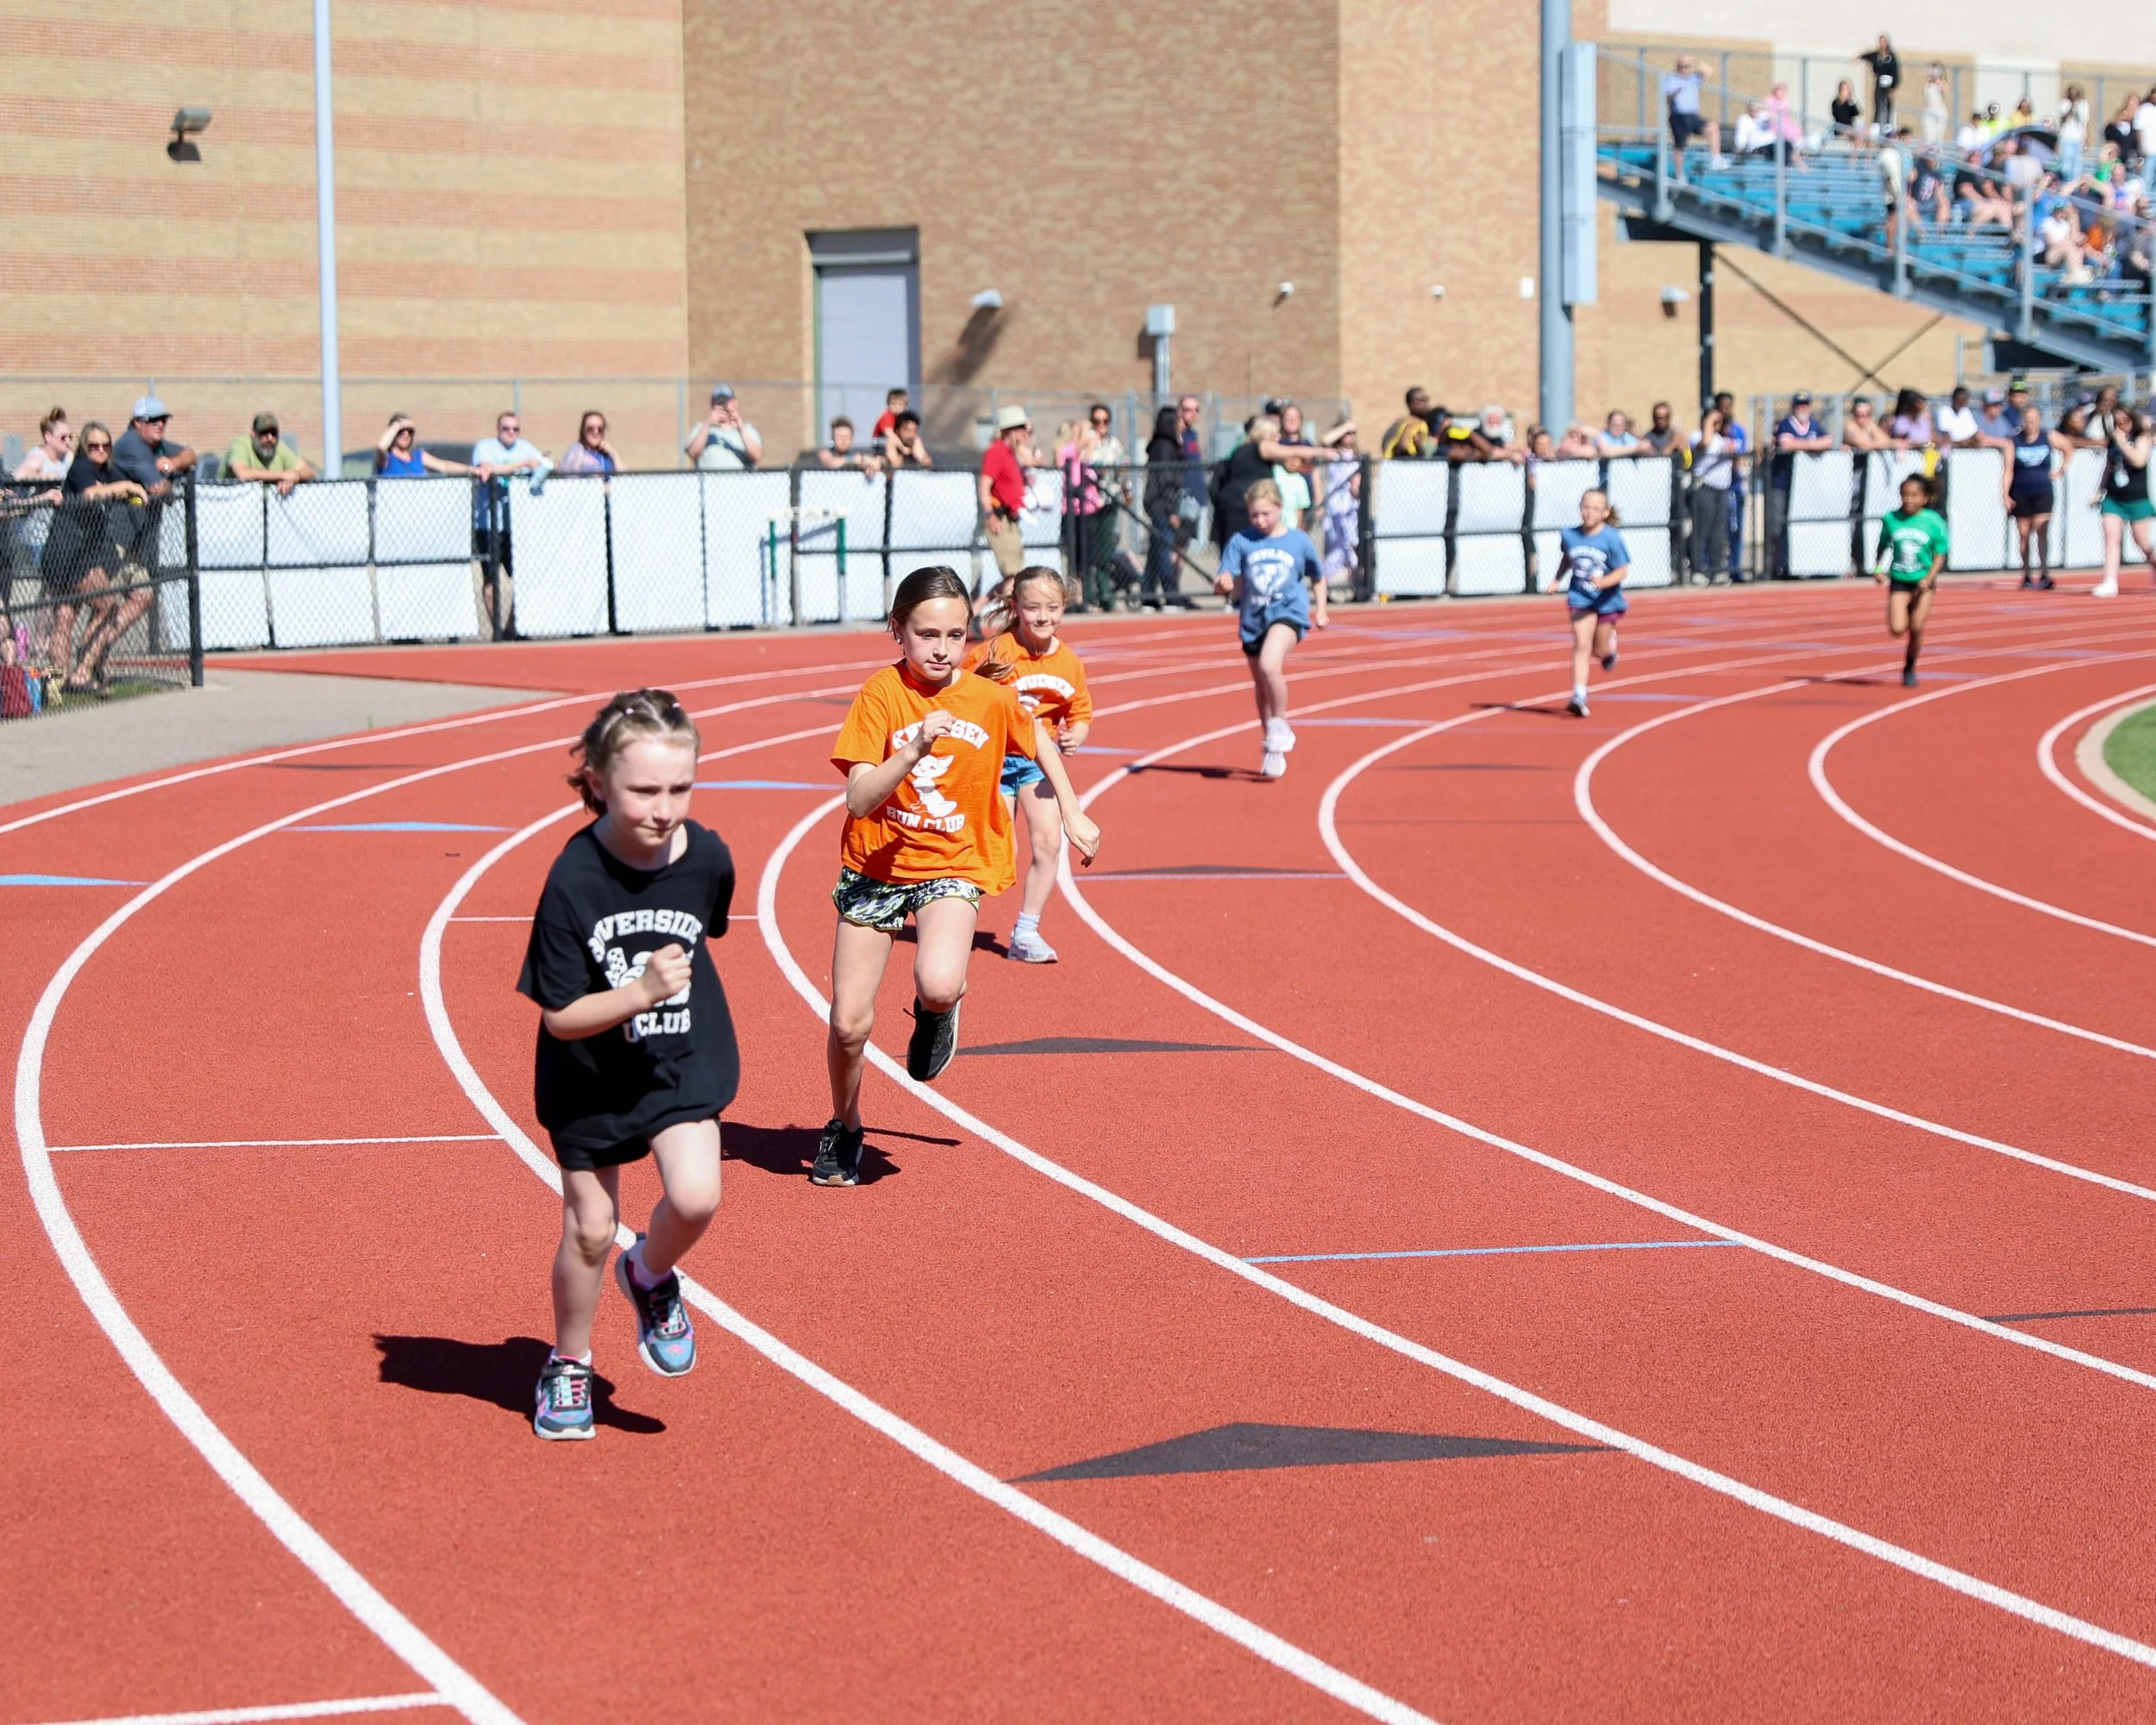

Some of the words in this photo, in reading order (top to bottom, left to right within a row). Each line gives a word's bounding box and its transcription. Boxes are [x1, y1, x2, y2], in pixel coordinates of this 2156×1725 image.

[1012, 674, 1075, 698] NUDSEN
[892, 718, 990, 750] KNSEN
[887, 806, 921, 828] RUN
[924, 813, 966, 832] CLUB
[587, 909, 703, 963] RIVERSIDE
[634, 1007, 691, 1037] CLUB
